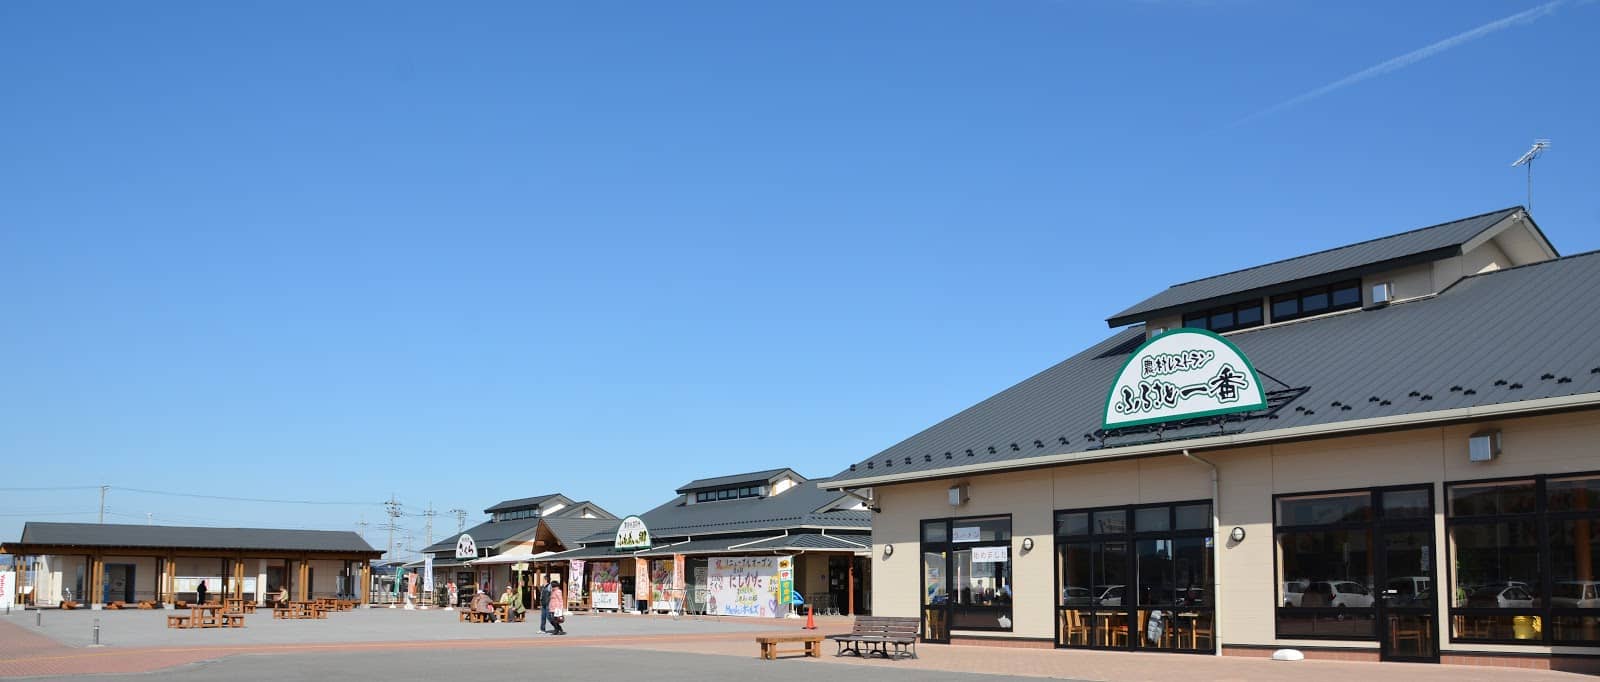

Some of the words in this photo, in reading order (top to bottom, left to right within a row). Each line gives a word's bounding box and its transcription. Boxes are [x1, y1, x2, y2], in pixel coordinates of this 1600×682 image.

[1142, 351, 1214, 377] 農村レストラン
[1116, 366, 1246, 412] ふるさと一番
